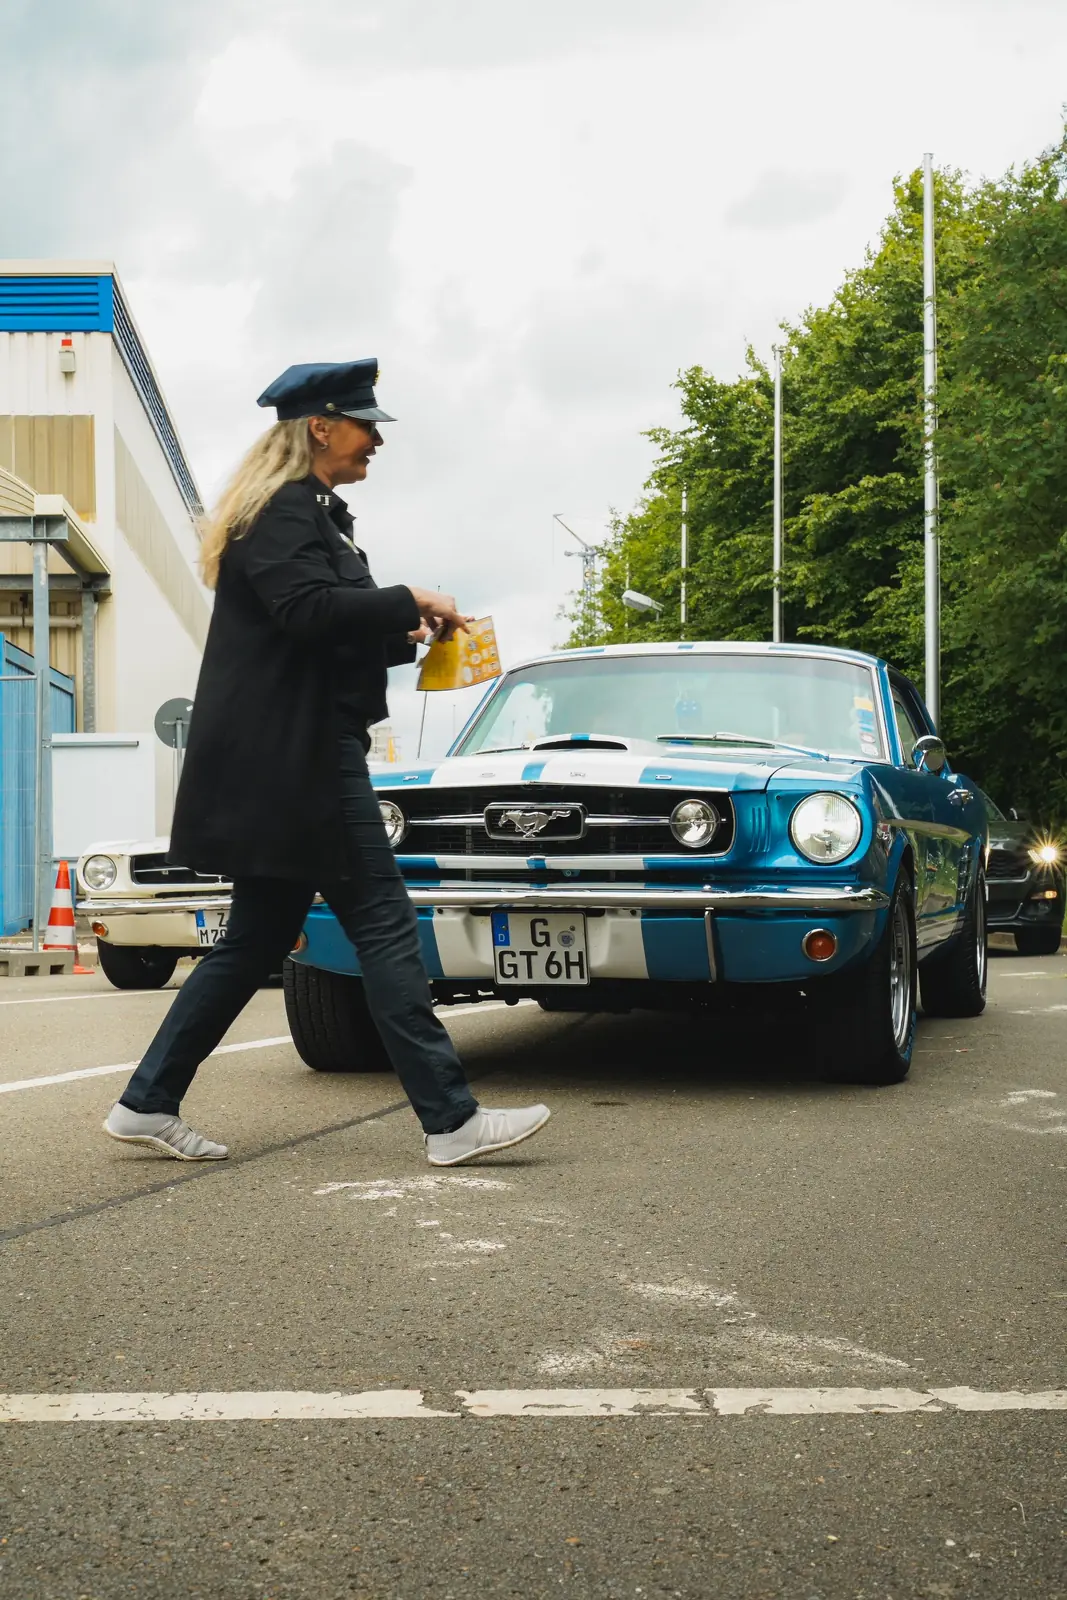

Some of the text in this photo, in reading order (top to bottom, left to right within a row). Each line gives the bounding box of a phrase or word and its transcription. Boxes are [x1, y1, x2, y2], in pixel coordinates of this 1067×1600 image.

[217, 912, 227, 927] Z
[498, 934, 505, 942] D
[530, 918, 550, 947] G
[499, 950, 585, 979] GT 6H
